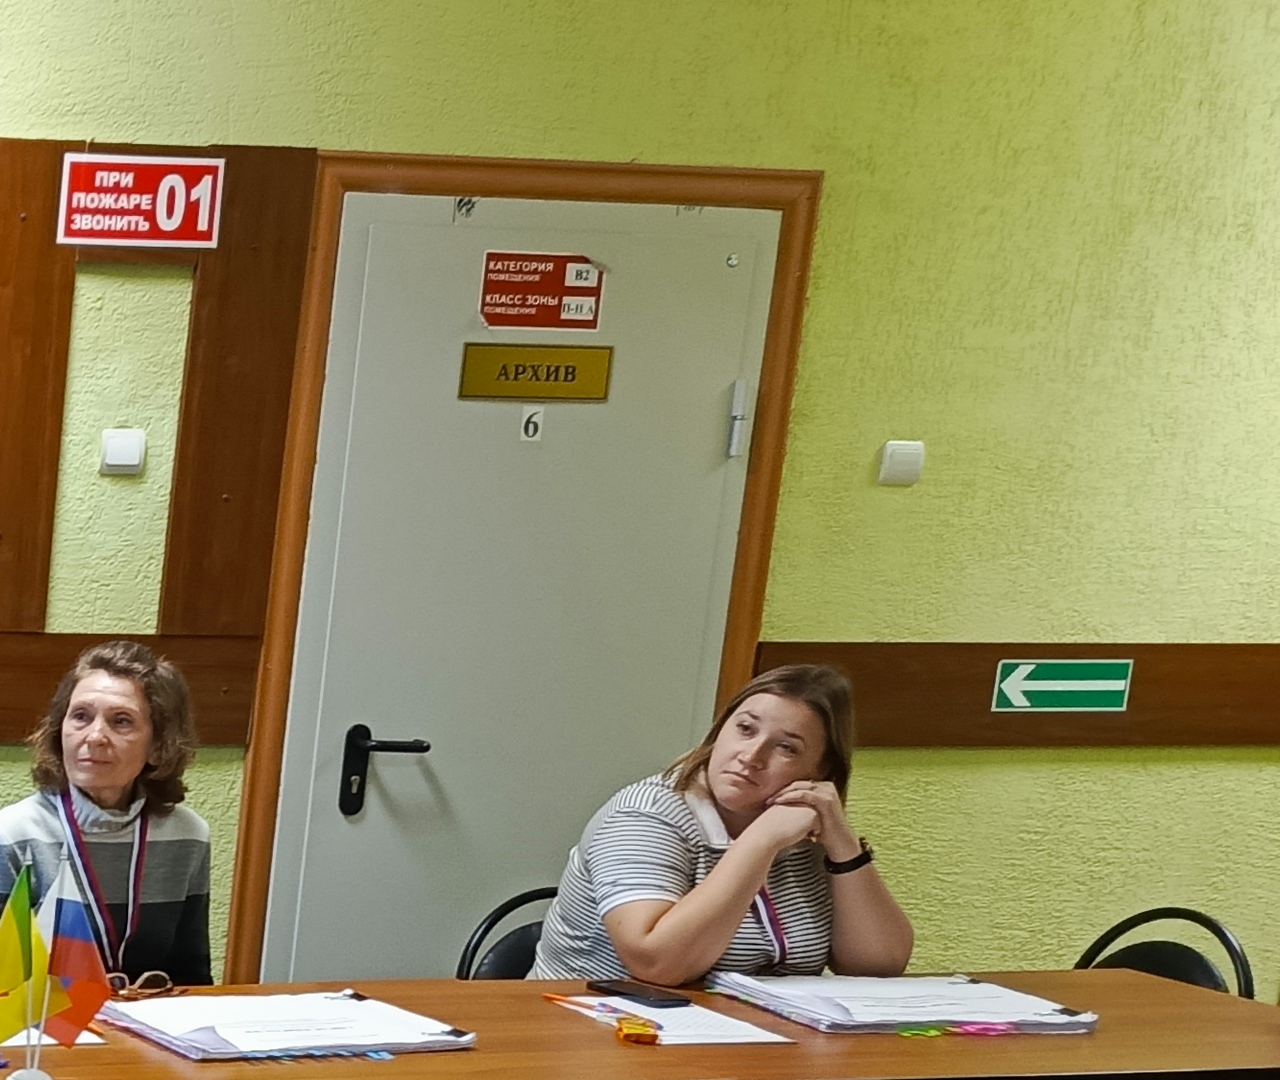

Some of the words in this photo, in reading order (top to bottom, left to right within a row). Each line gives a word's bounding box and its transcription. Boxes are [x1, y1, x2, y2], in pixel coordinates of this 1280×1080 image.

[94, 170, 135, 188] ПРИ
[71, 191, 154, 210] ПОЖАРЕ
[155, 173, 214, 232] 01
[70, 213, 150, 232] ЗВОНИТЬ
[488, 260, 554, 272] КАТЕГОРИЯ
[485, 294, 523, 305] КЛАСС
[525, 295, 559, 305] ЗОНЫ
[495, 363, 578, 382] АРХИВ
[523, 411, 542, 438] 6
